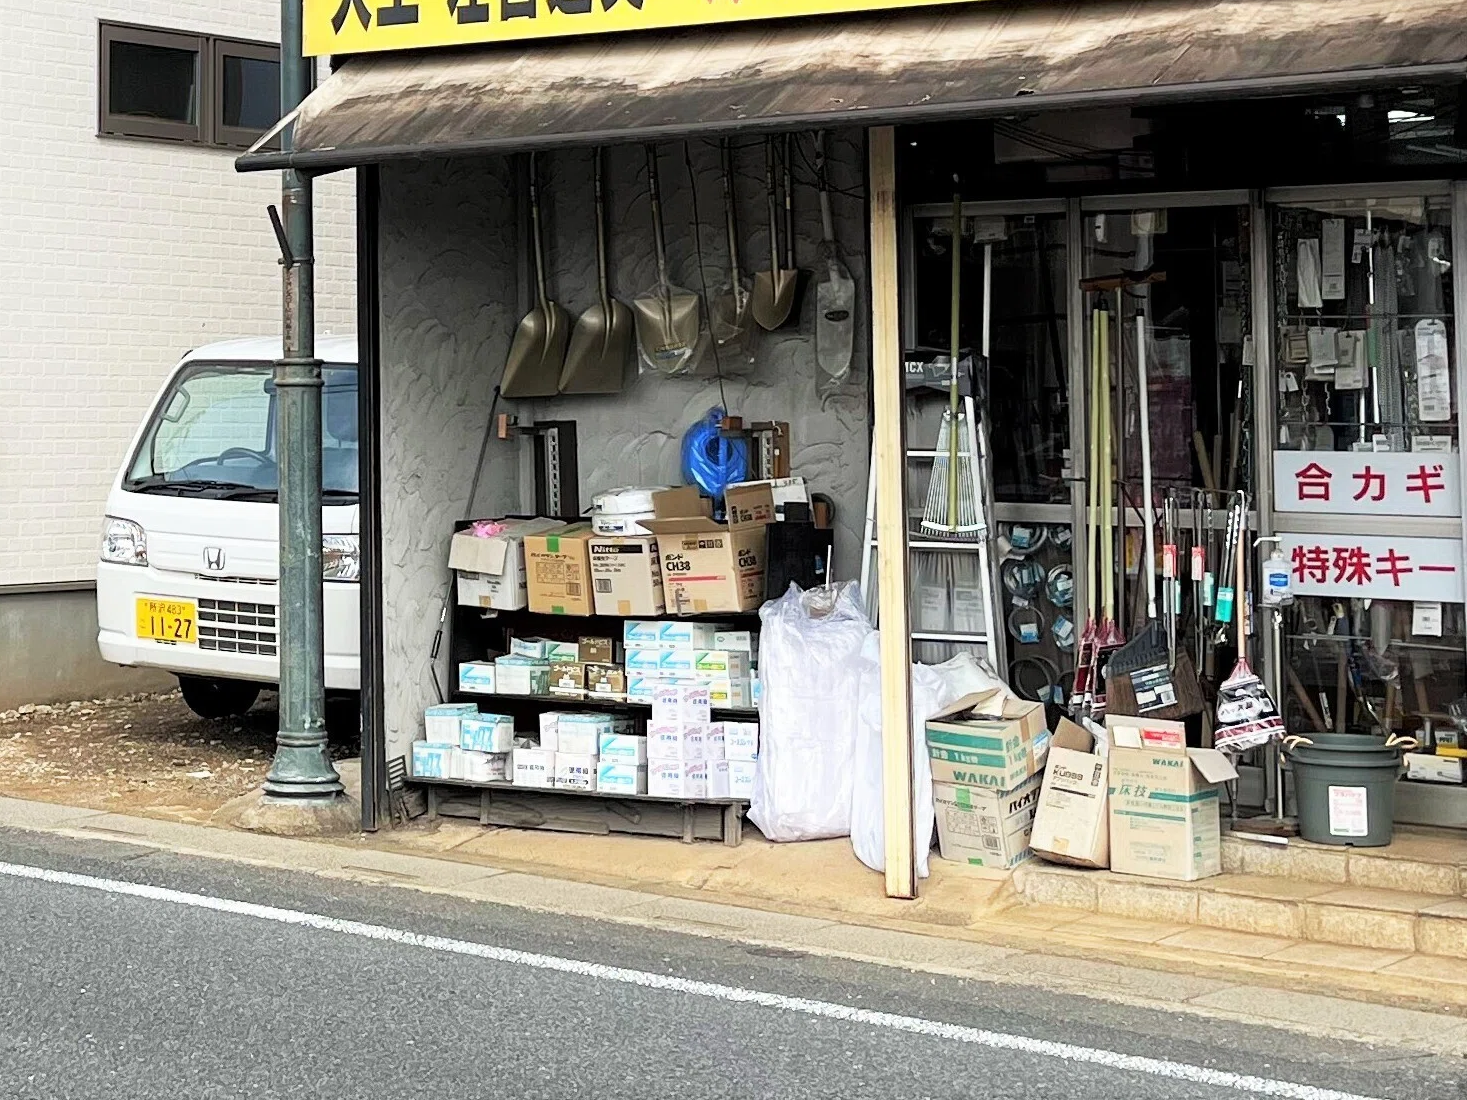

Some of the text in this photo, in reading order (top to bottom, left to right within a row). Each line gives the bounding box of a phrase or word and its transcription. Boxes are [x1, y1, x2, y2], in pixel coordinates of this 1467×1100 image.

[1294, 462, 1445, 504] 合カギ
[594, 545, 619, 553] Nitto
[666, 560, 690, 572] CH38
[1291, 545, 1456, 588] 特殊キー
[151, 616, 192, 639] 11-27
[1152, 758, 1184, 768] WAKAI
[953, 770, 1006, 787] WAKAI
[1119, 784, 1148, 797] 床技
